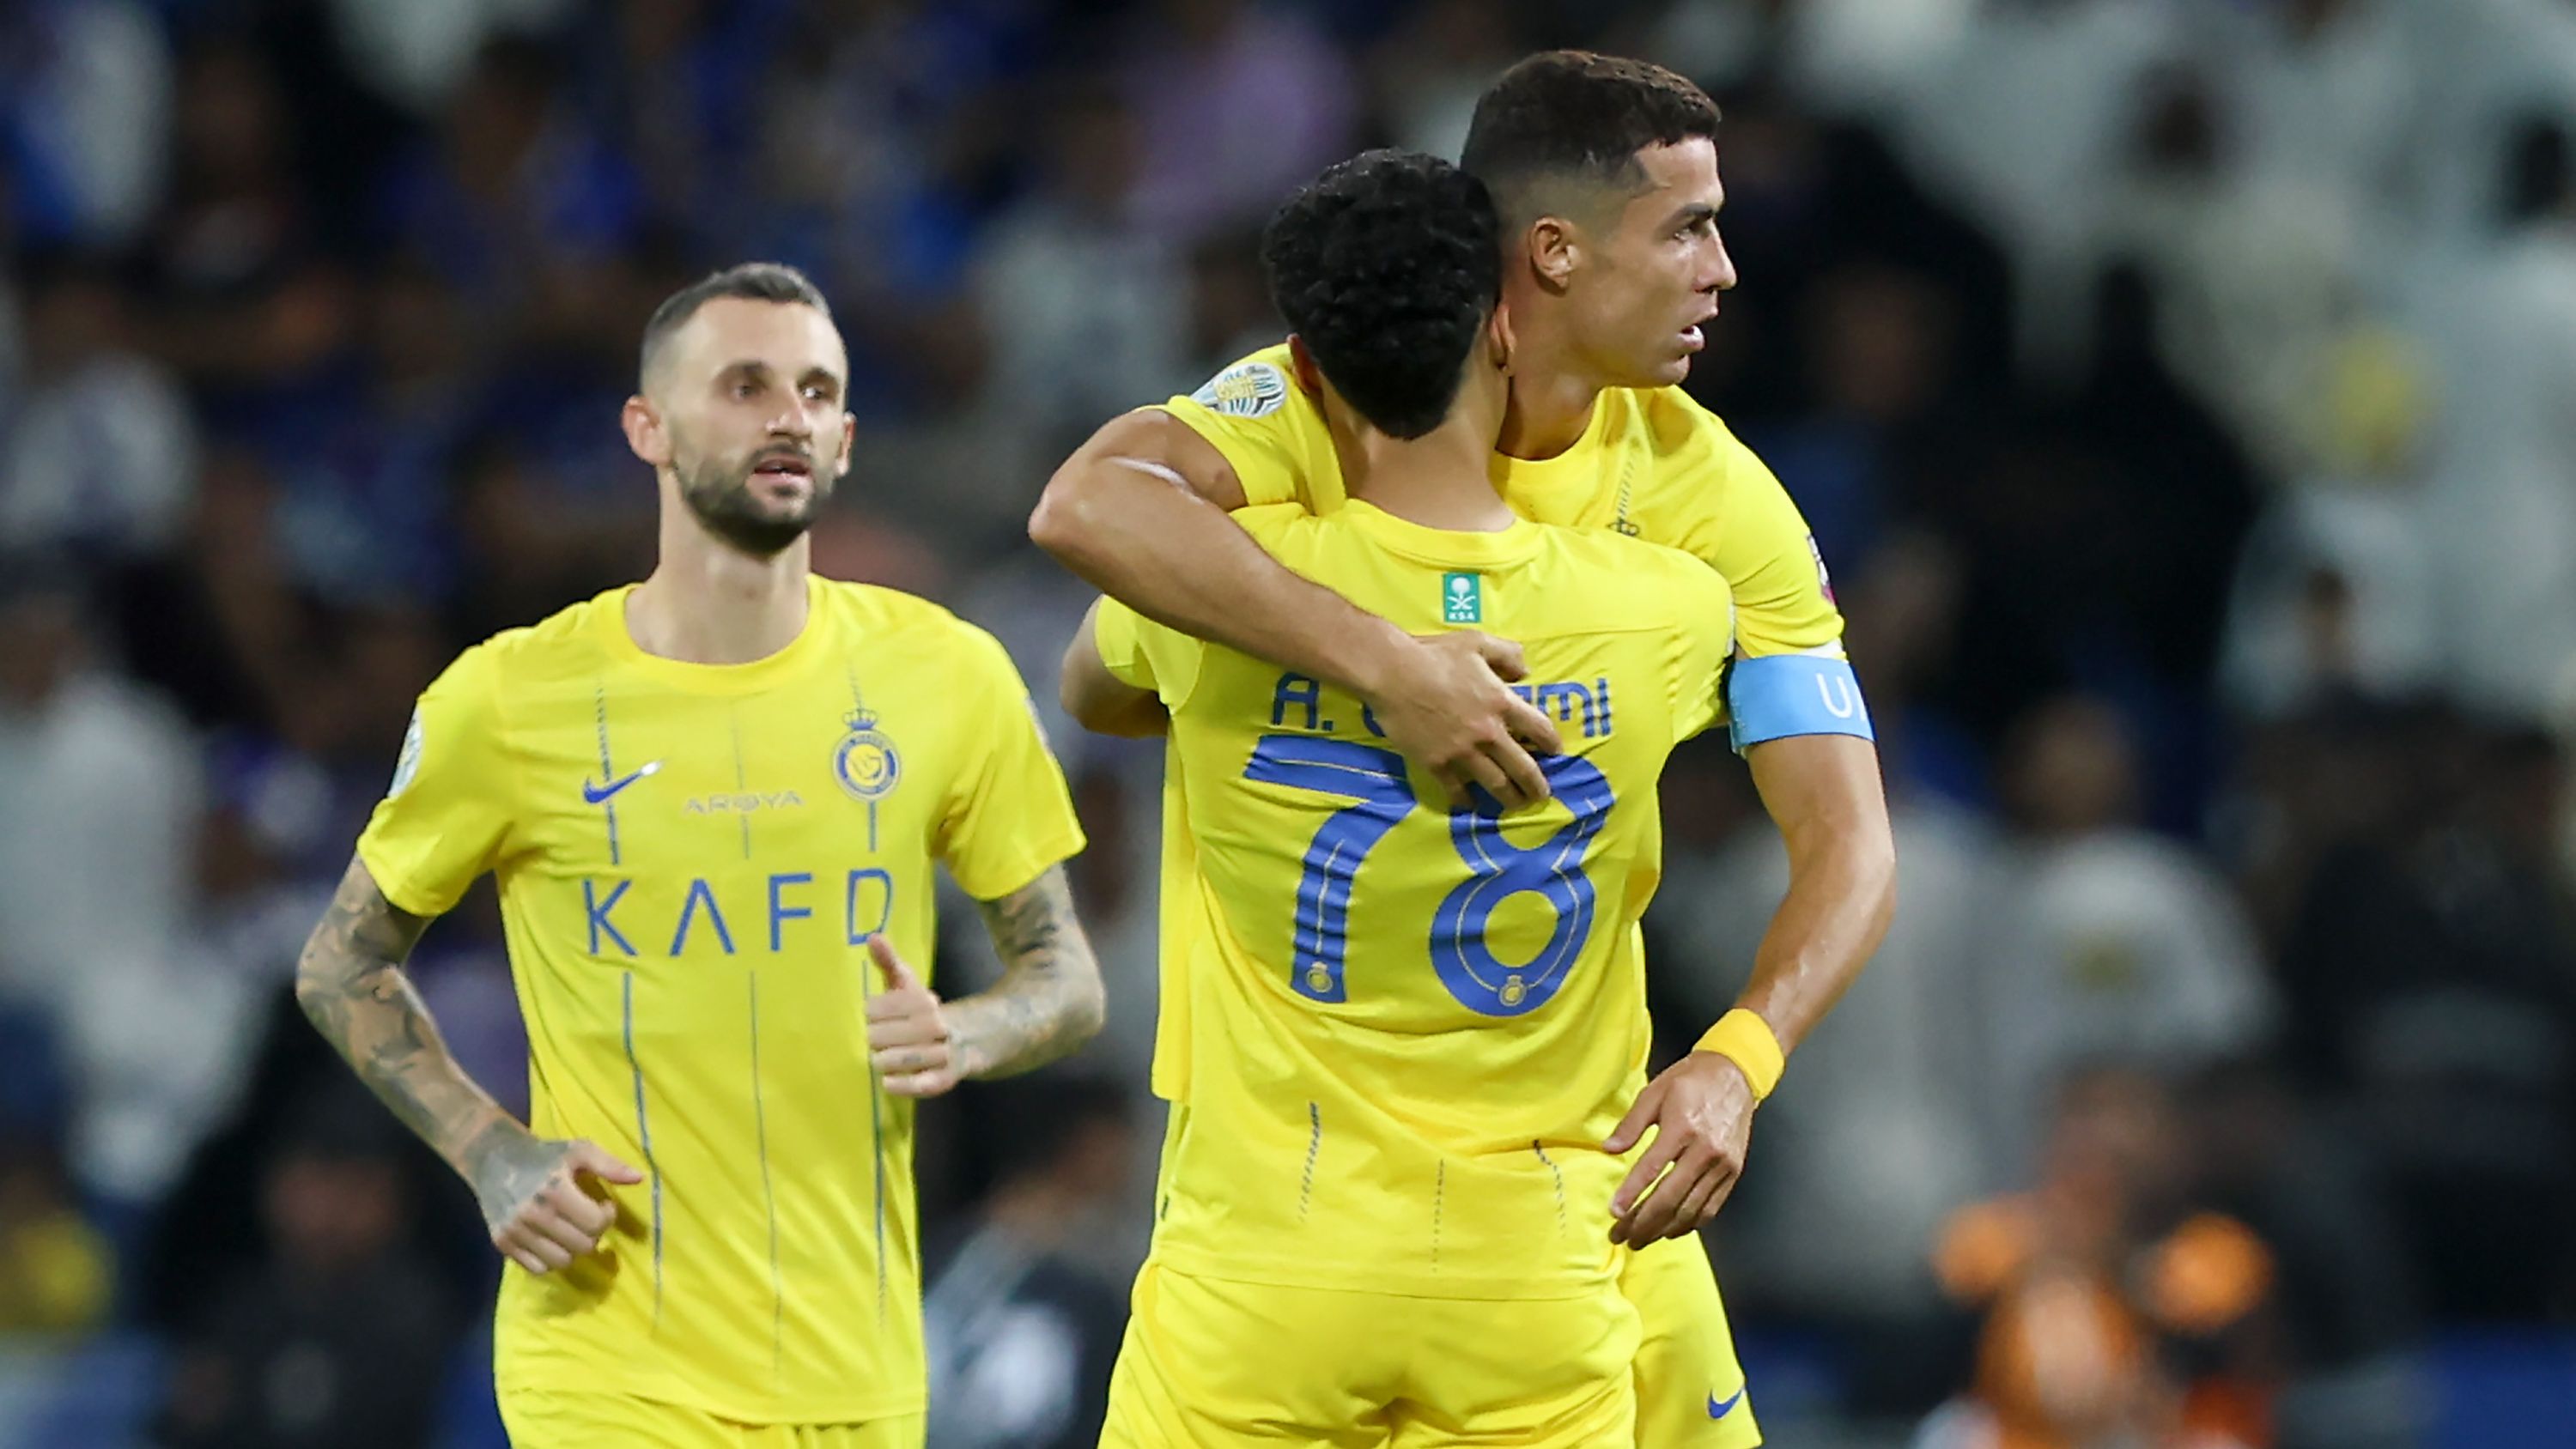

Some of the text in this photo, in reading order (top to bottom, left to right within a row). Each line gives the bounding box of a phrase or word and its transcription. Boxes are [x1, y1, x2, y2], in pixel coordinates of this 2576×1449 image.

[1271, 672, 1334, 731] A.
[1816, 673, 1867, 722] U
[683, 790, 805, 815] AROYA
[1243, 734, 1616, 1016] 78
[582, 868, 892, 955] KAFD
